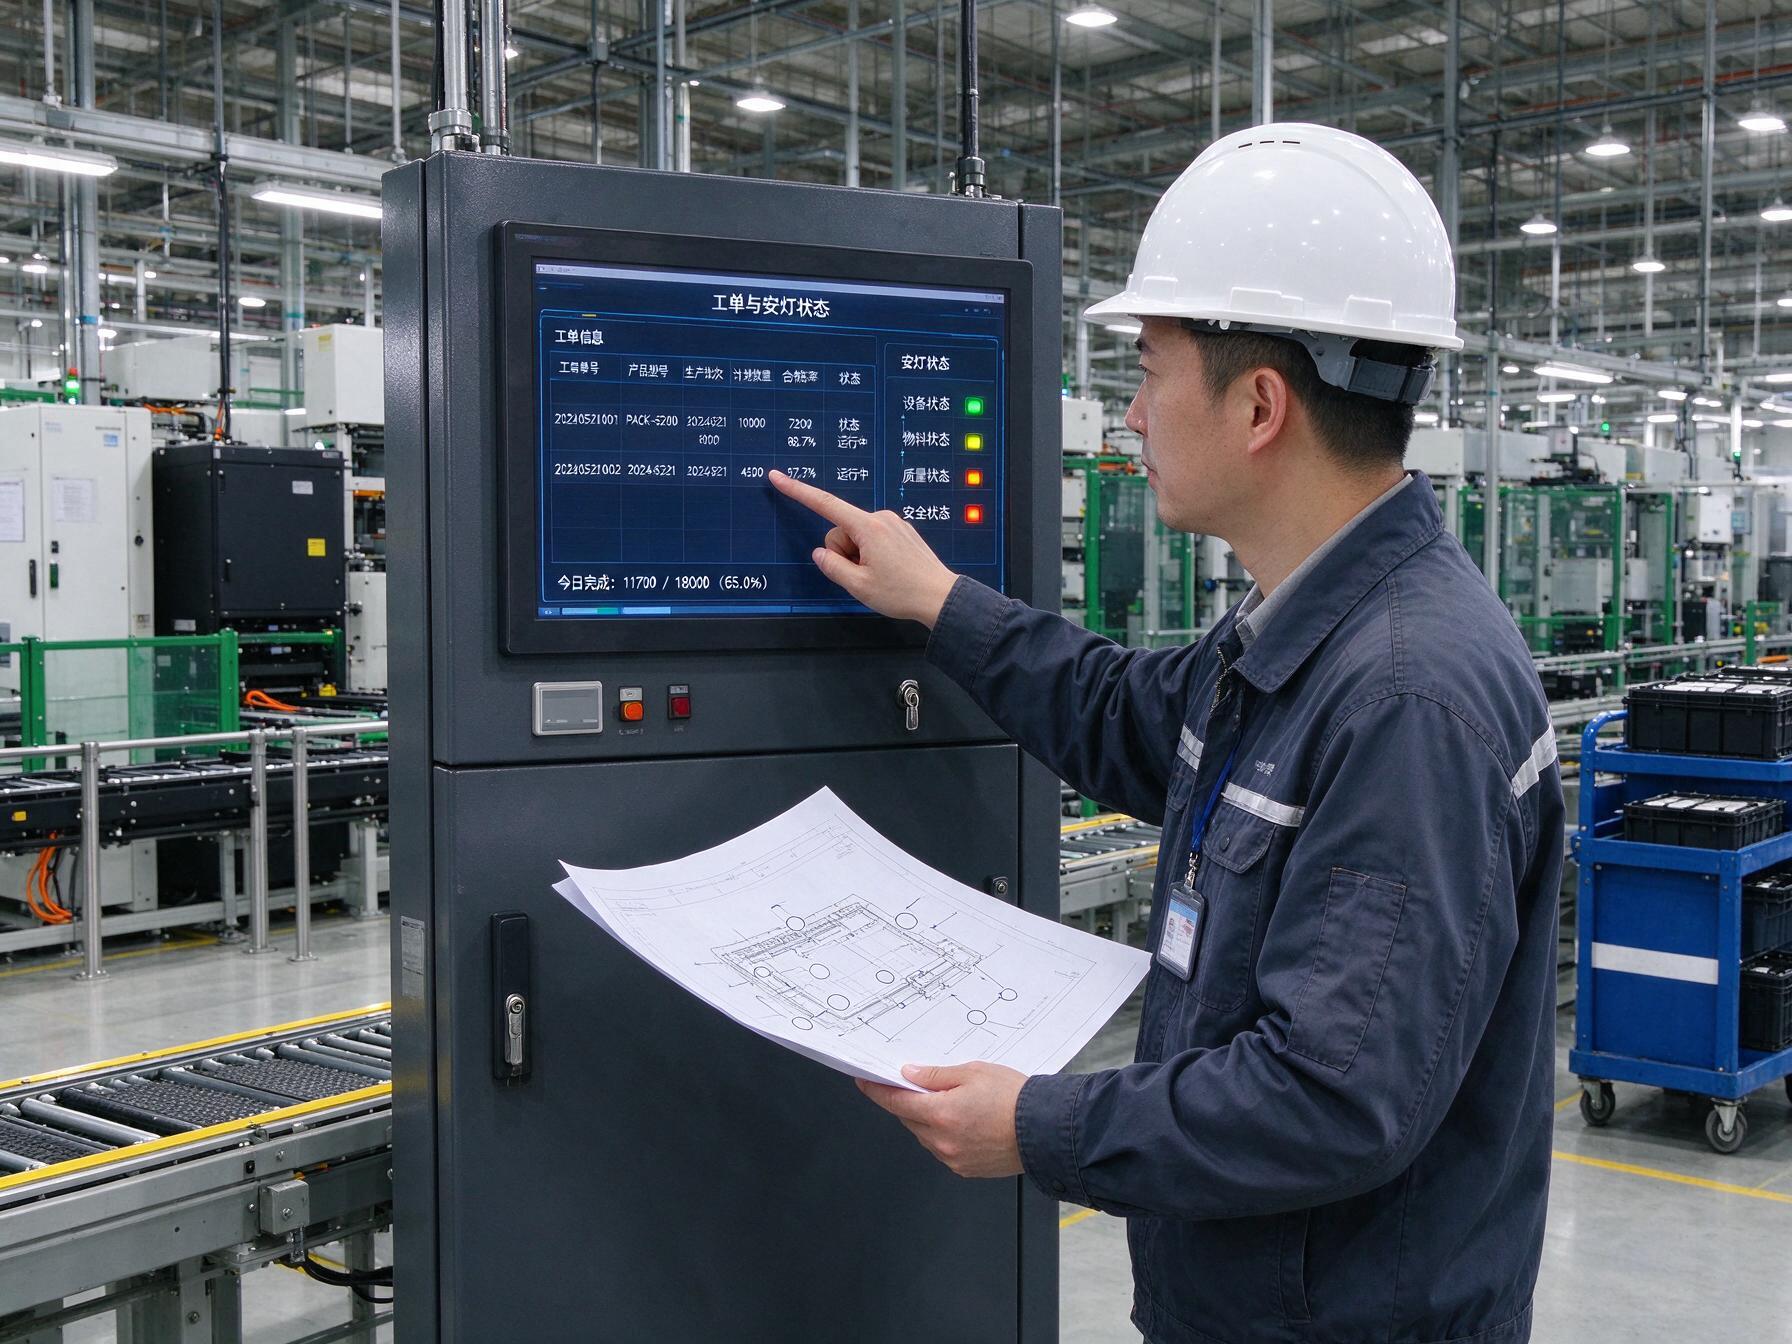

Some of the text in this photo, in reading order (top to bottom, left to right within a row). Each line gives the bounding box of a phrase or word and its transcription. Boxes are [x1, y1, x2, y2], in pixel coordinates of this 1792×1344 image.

[710, 292, 831, 319] 工单与安灯状态
[554, 328, 604, 346] 工单信息
[901, 353, 950, 371] 安灯状态
[902, 395, 951, 412] 设备状态
[902, 504, 951, 521] 安全状态
[623, 575, 657, 590] 11700
